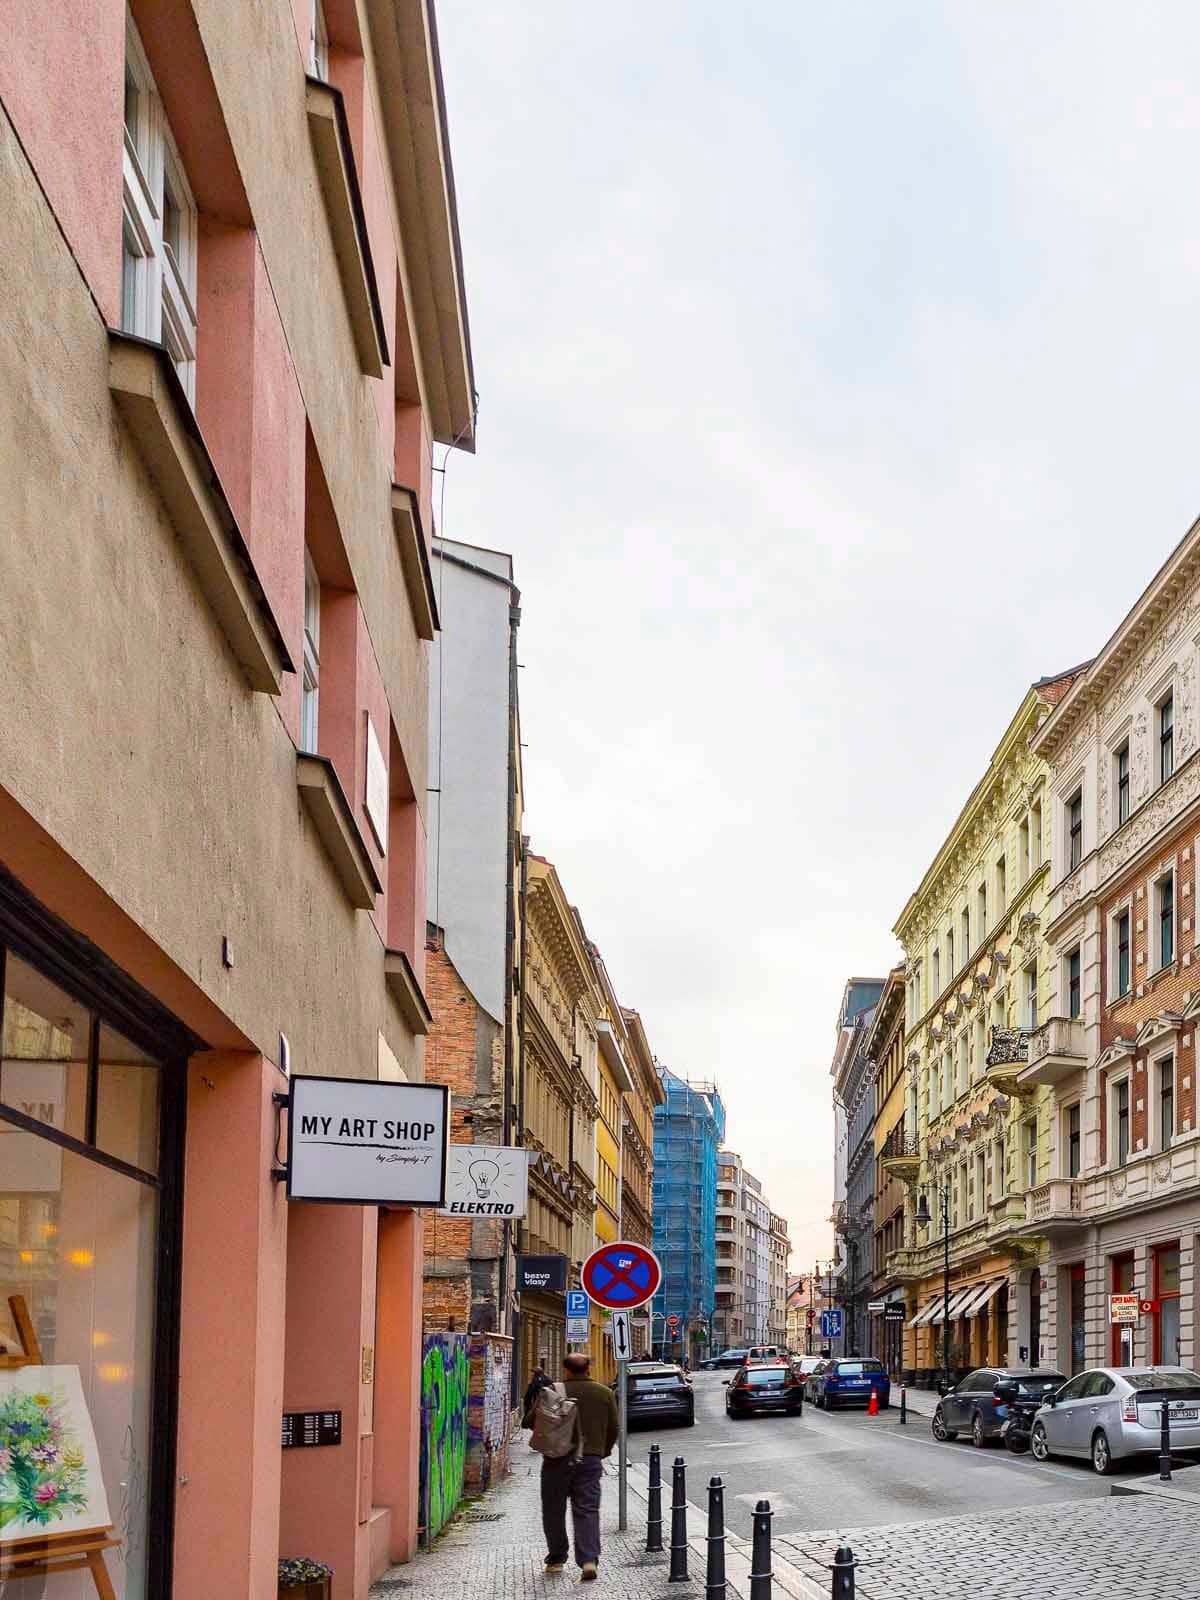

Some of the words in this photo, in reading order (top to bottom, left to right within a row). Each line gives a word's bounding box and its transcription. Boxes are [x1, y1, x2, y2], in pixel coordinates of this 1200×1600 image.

[301, 1116, 333, 1135] MY
[339, 1118, 378, 1138] ART
[383, 1120, 435, 1141] SHOP
[375, 1154, 386, 1163] by
[450, 1201, 515, 1215] ELEKTRO
[524, 1271, 551, 1280] bezva
[524, 1279, 547, 1287] vlasy
